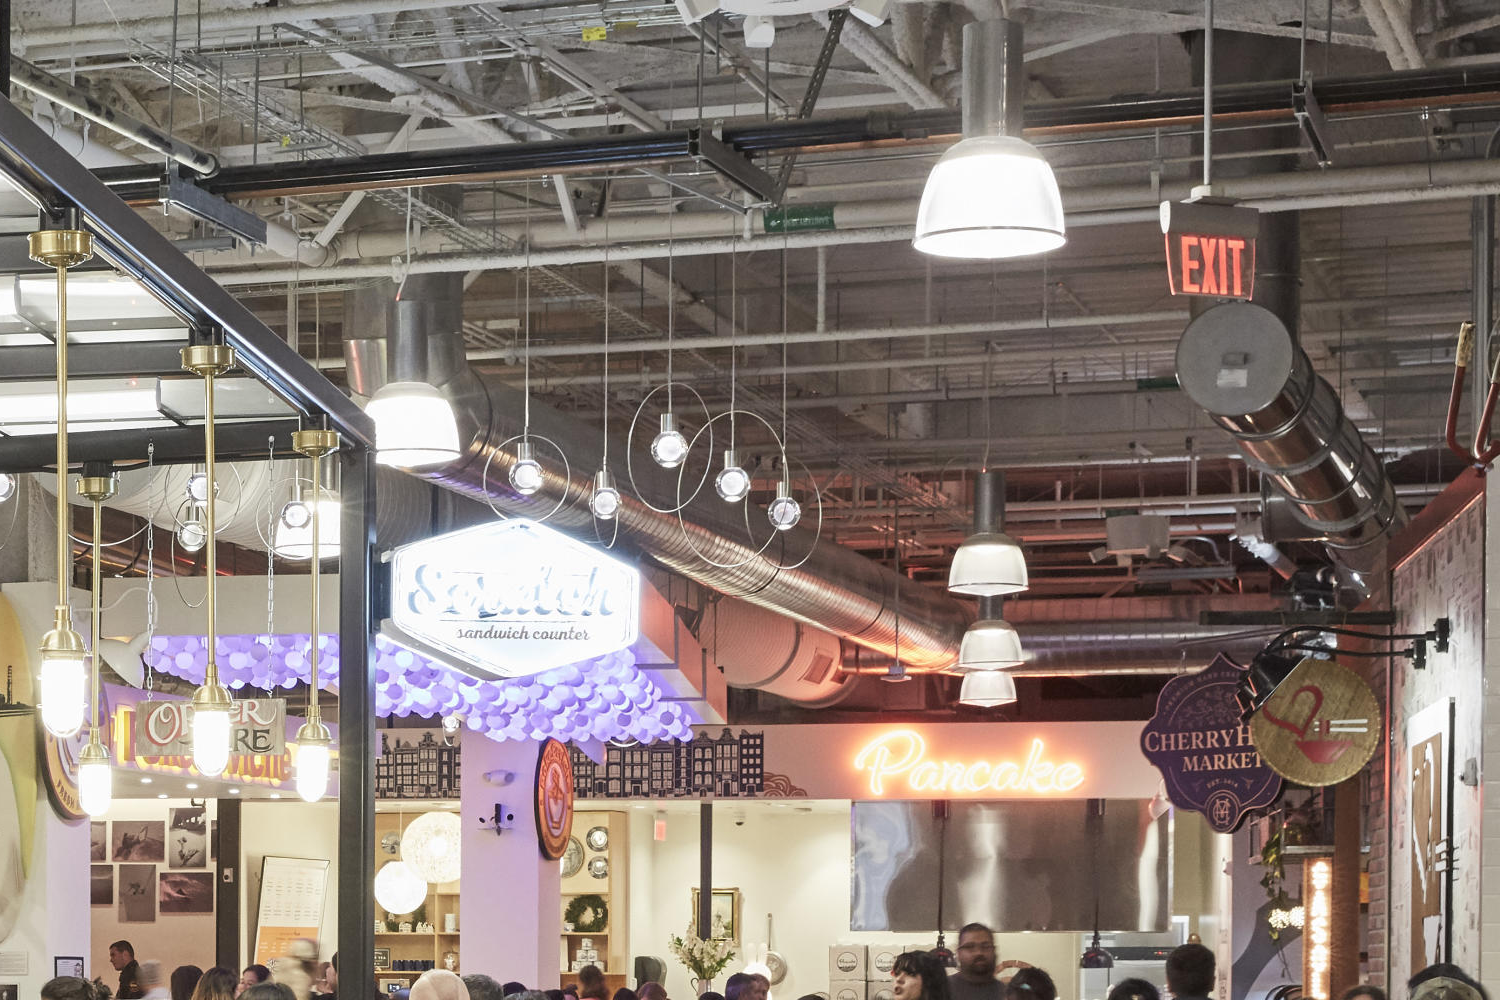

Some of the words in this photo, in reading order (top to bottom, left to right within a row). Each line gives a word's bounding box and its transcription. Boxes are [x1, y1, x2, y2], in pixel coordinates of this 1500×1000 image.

[1181, 235, 1245, 296] EXIT
[457, 625, 529, 641] sandwich
[532, 626, 591, 641] counter
[146, 700, 276, 745] OER
[854, 730, 1085, 795] Pancake
[1182, 752, 1263, 772] MARKET
